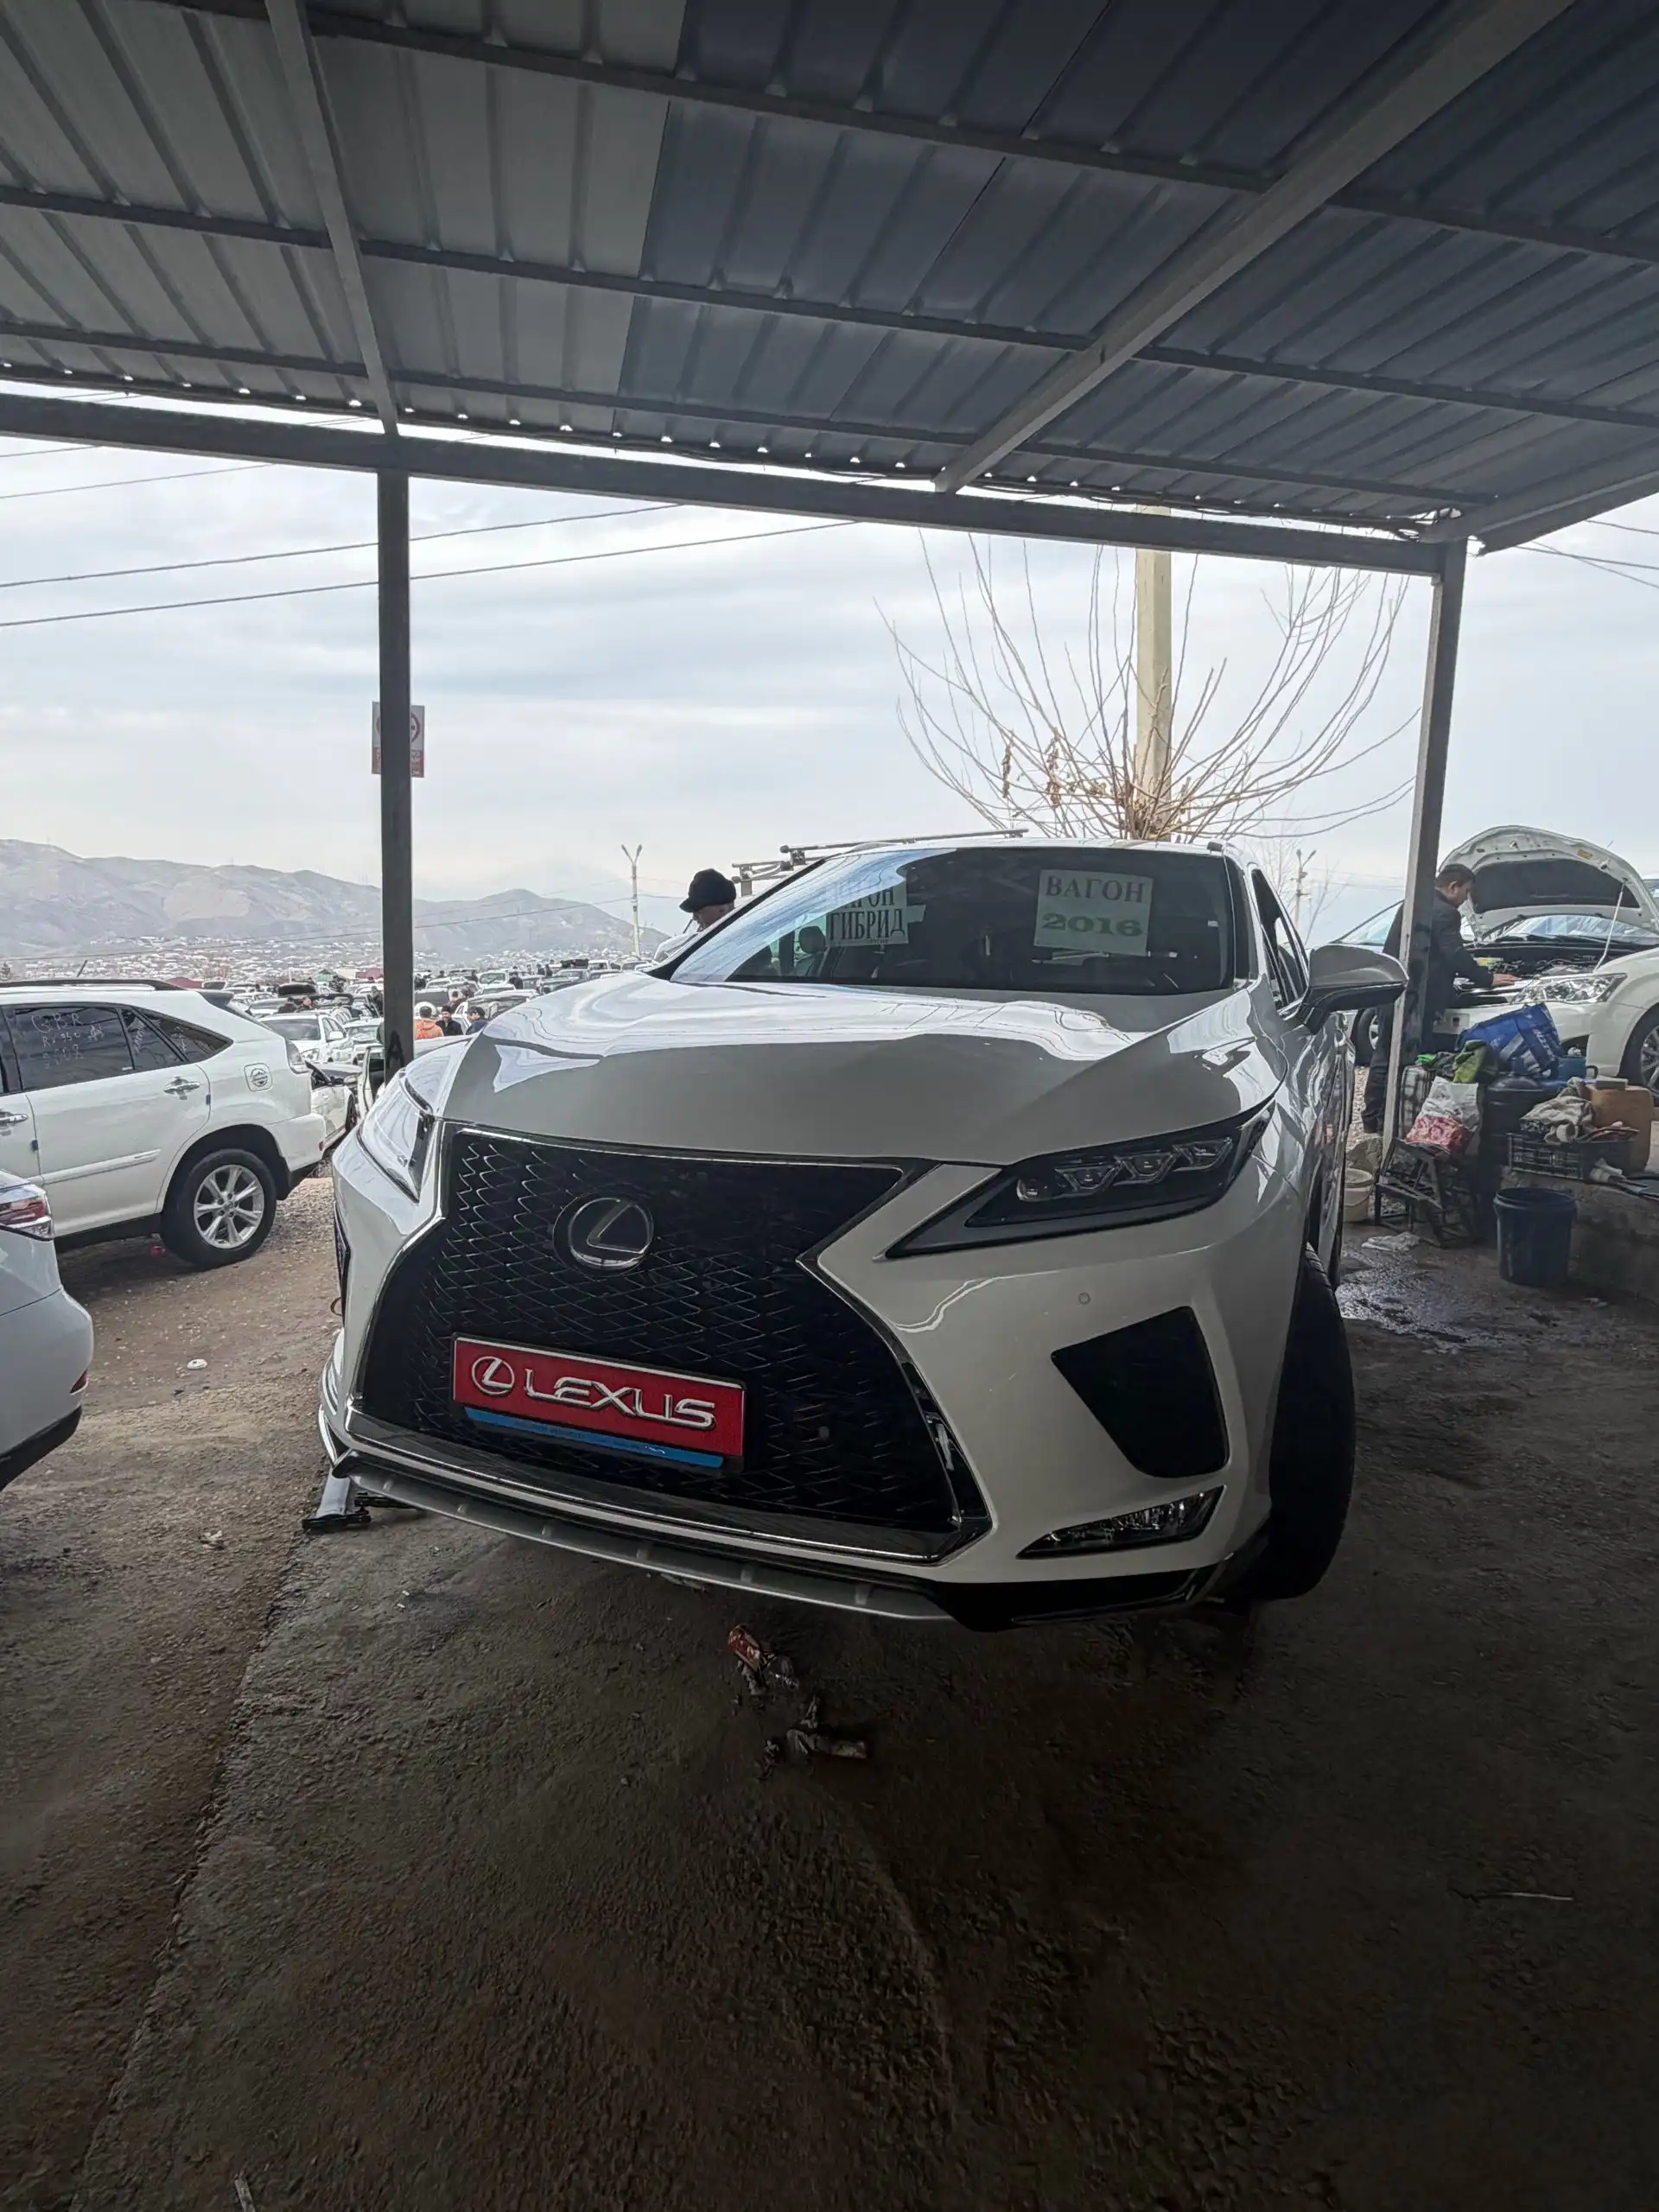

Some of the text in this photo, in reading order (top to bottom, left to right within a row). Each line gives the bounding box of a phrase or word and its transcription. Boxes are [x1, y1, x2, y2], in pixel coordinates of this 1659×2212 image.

[1046, 875, 1146, 903] ВАГОН
[829, 909, 906, 941] ГИБРИД
[1042, 912, 1143, 937] 2016
[524, 1368, 716, 1429] LEXUS
